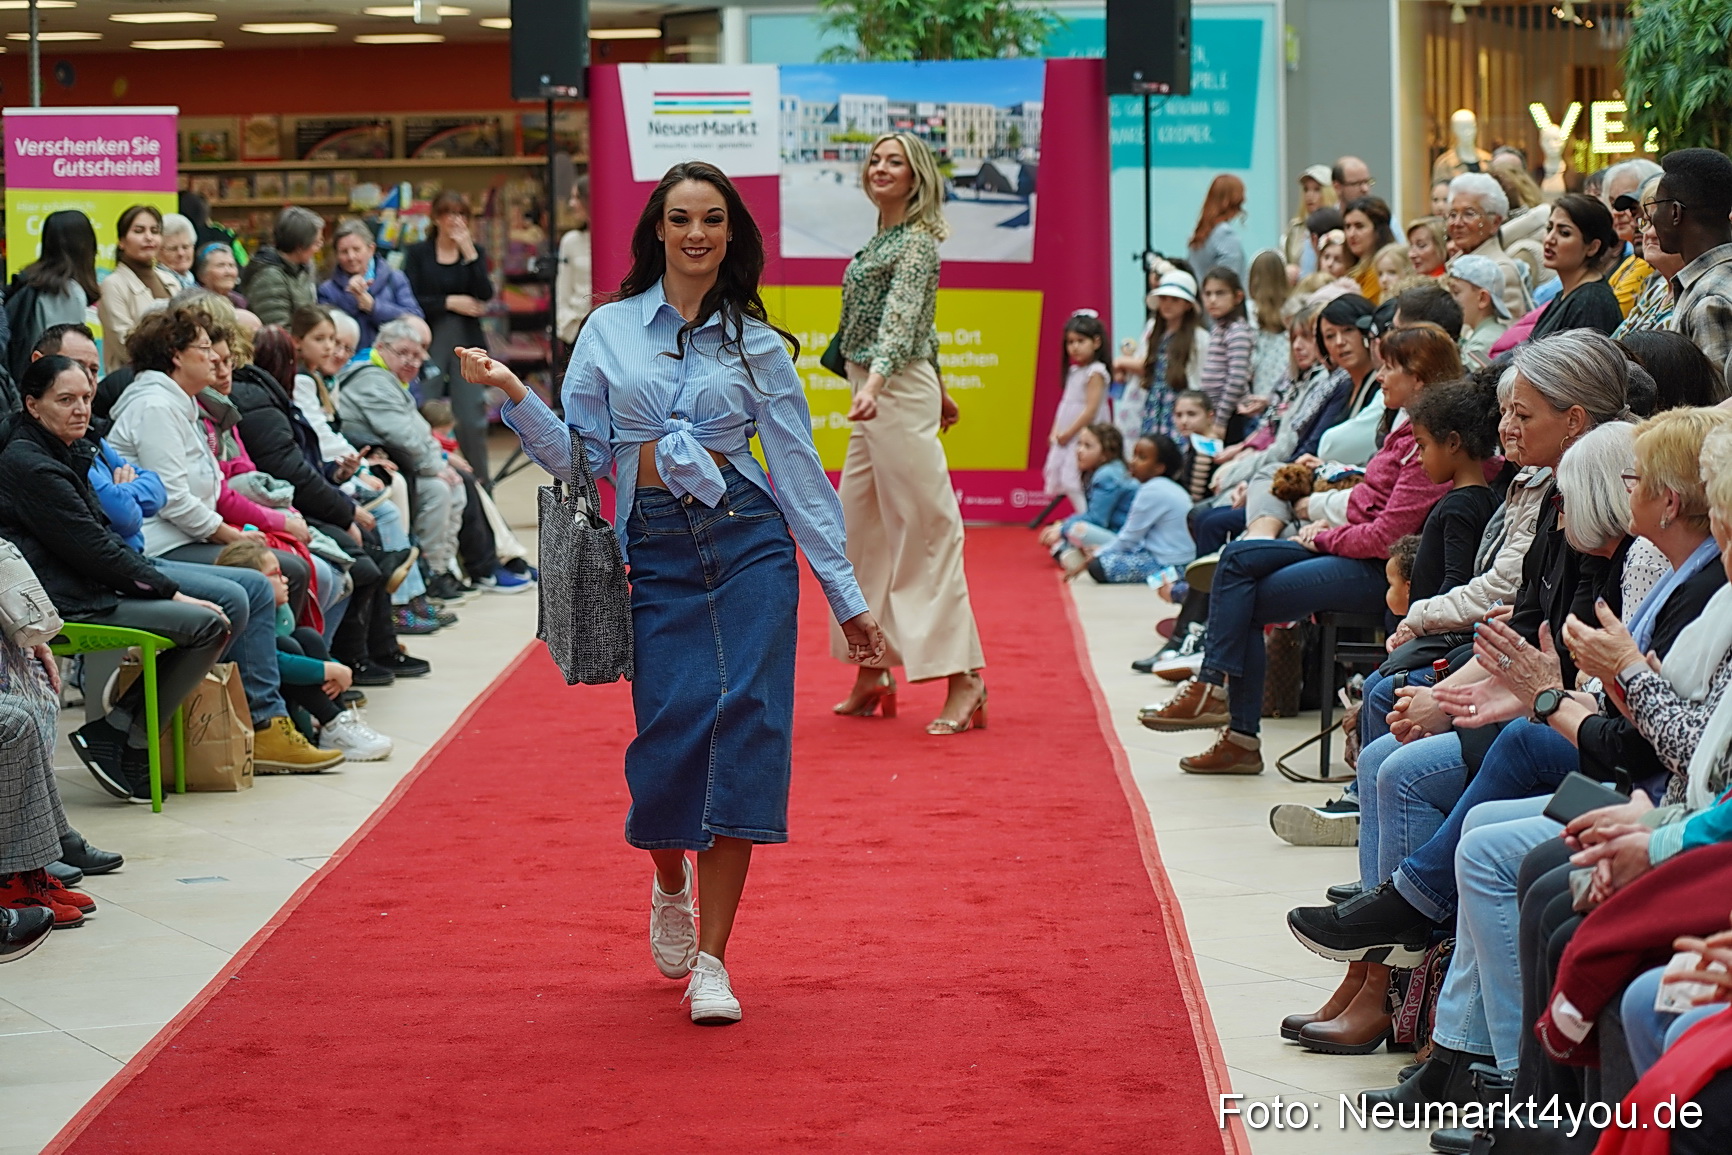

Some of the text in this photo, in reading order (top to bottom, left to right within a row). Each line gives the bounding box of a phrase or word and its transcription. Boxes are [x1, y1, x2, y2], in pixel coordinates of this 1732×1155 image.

[648, 119, 758, 136] NeuerMarkt
[15, 136, 161, 156] Verschenken Sie
[53, 156, 161, 177] Gutscheine!
[954, 327, 982, 346] Ort
